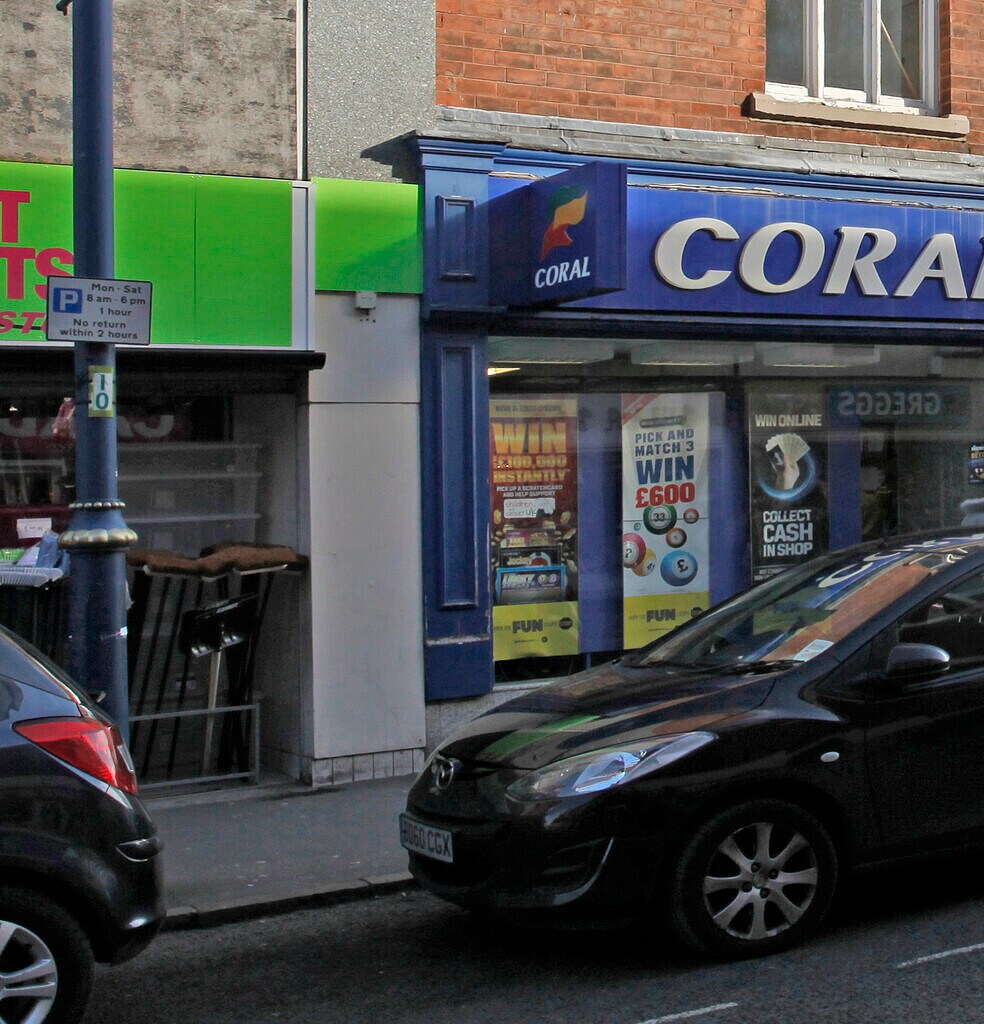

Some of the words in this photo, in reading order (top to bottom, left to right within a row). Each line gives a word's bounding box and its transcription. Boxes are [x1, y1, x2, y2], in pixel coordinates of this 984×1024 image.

[535, 257, 590, 289] CORAL
[91, 283, 114, 292] Mon
[123, 285, 142, 294] Sat
[59, 290, 79, 311] P
[87, 294, 93, 302] 8
[121, 296, 127, 304] 6
[100, 307, 104, 315] 1
[108, 308, 132, 316] hour
[0, 311, 47, 334] ST
[73, 318, 89, 327] No
[93, 321, 126, 329] return
[60, 328, 93, 337] within
[98, 330, 104, 338] 2
[108, 330, 138, 339] hours
[755, 414, 778, 427] WIN
[779, 414, 822, 426] ONLINE
[492, 423, 567, 454] WIN
[635, 431, 663, 443] PICK
[668, 429, 694, 441] AND
[635, 442, 680, 456] MATCH
[686, 441, 694, 452] 3
[493, 469, 566, 483] INSTANTLY
[636, 455, 694, 485] WIN
[635, 482, 695, 508] £600
[654, 512, 665, 522] 33
[763, 509, 812, 524] COLLECT
[763, 523, 814, 543] CASH
[763, 544, 777, 557] IN
[778, 542, 814, 556] SHOP
[646, 609, 676, 623] FUN
[512, 619, 543, 633] FUN
[428, 829, 451, 857] CGX
